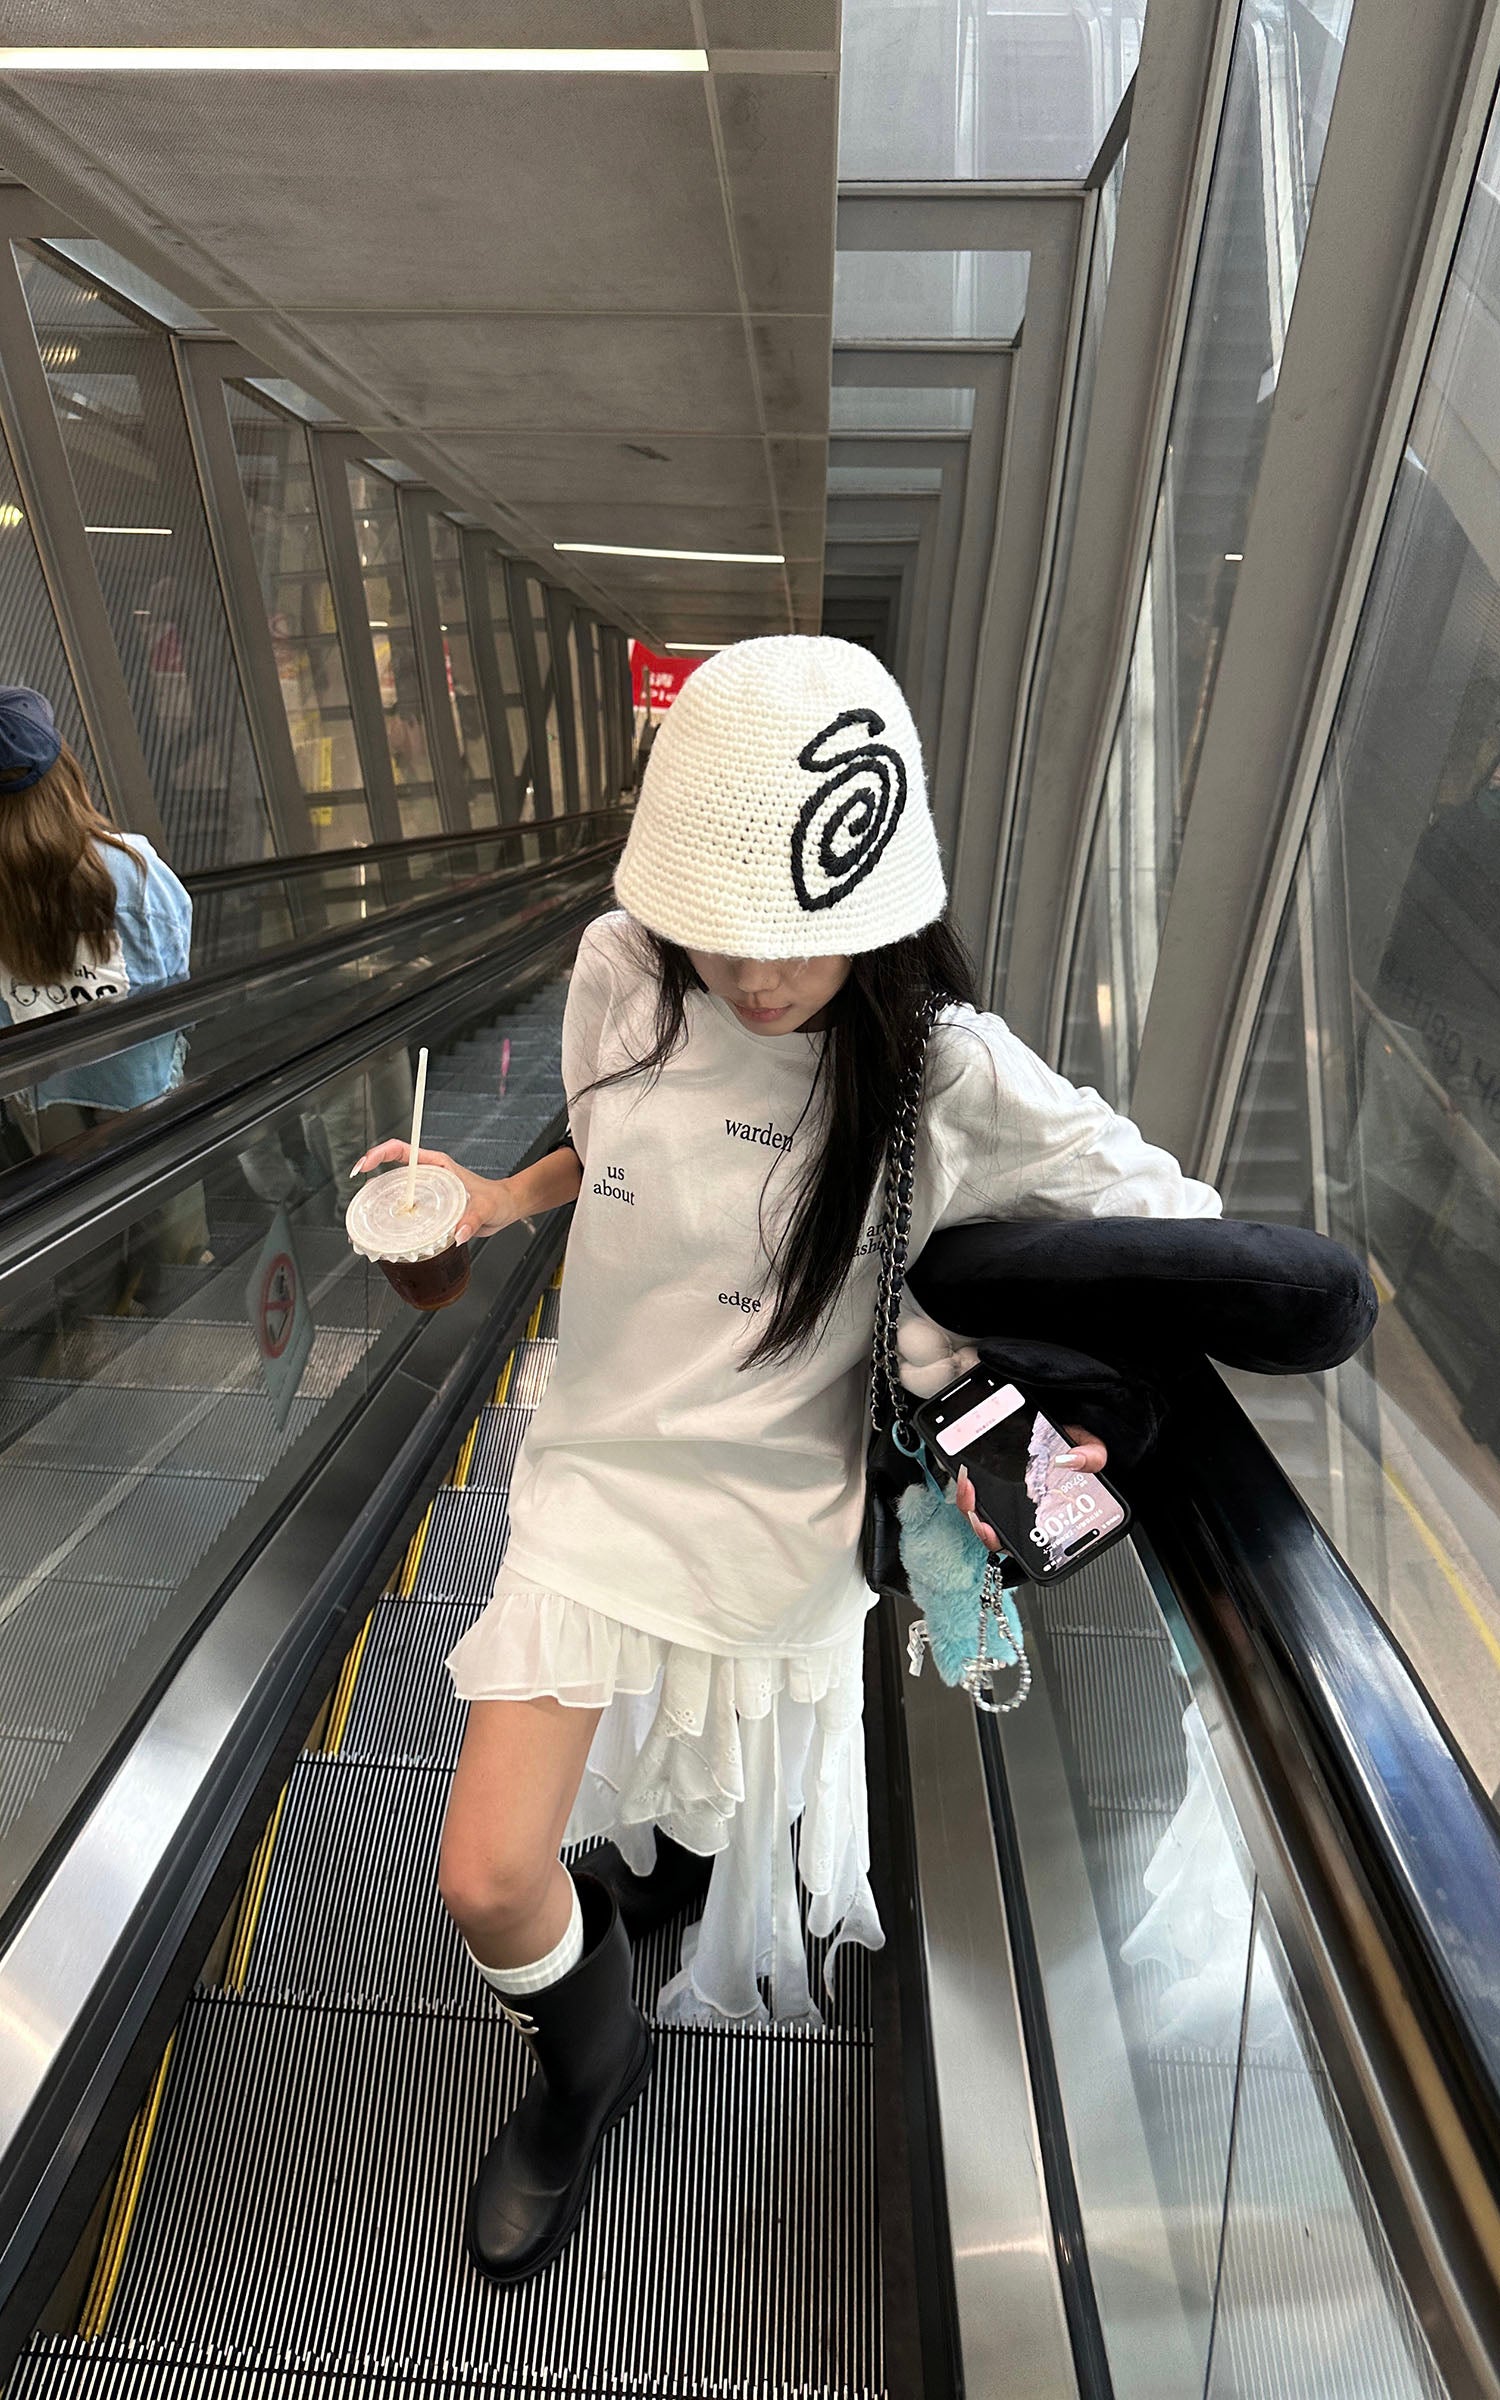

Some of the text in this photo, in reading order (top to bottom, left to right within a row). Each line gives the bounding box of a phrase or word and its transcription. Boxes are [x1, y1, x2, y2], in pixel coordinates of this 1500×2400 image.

[725, 1119, 793, 1152] warden
[607, 1165, 625, 1180] us
[593, 1180, 635, 1205] about
[718, 1291, 761, 1313] edge
[1029, 1494, 1096, 1547] 07:06
